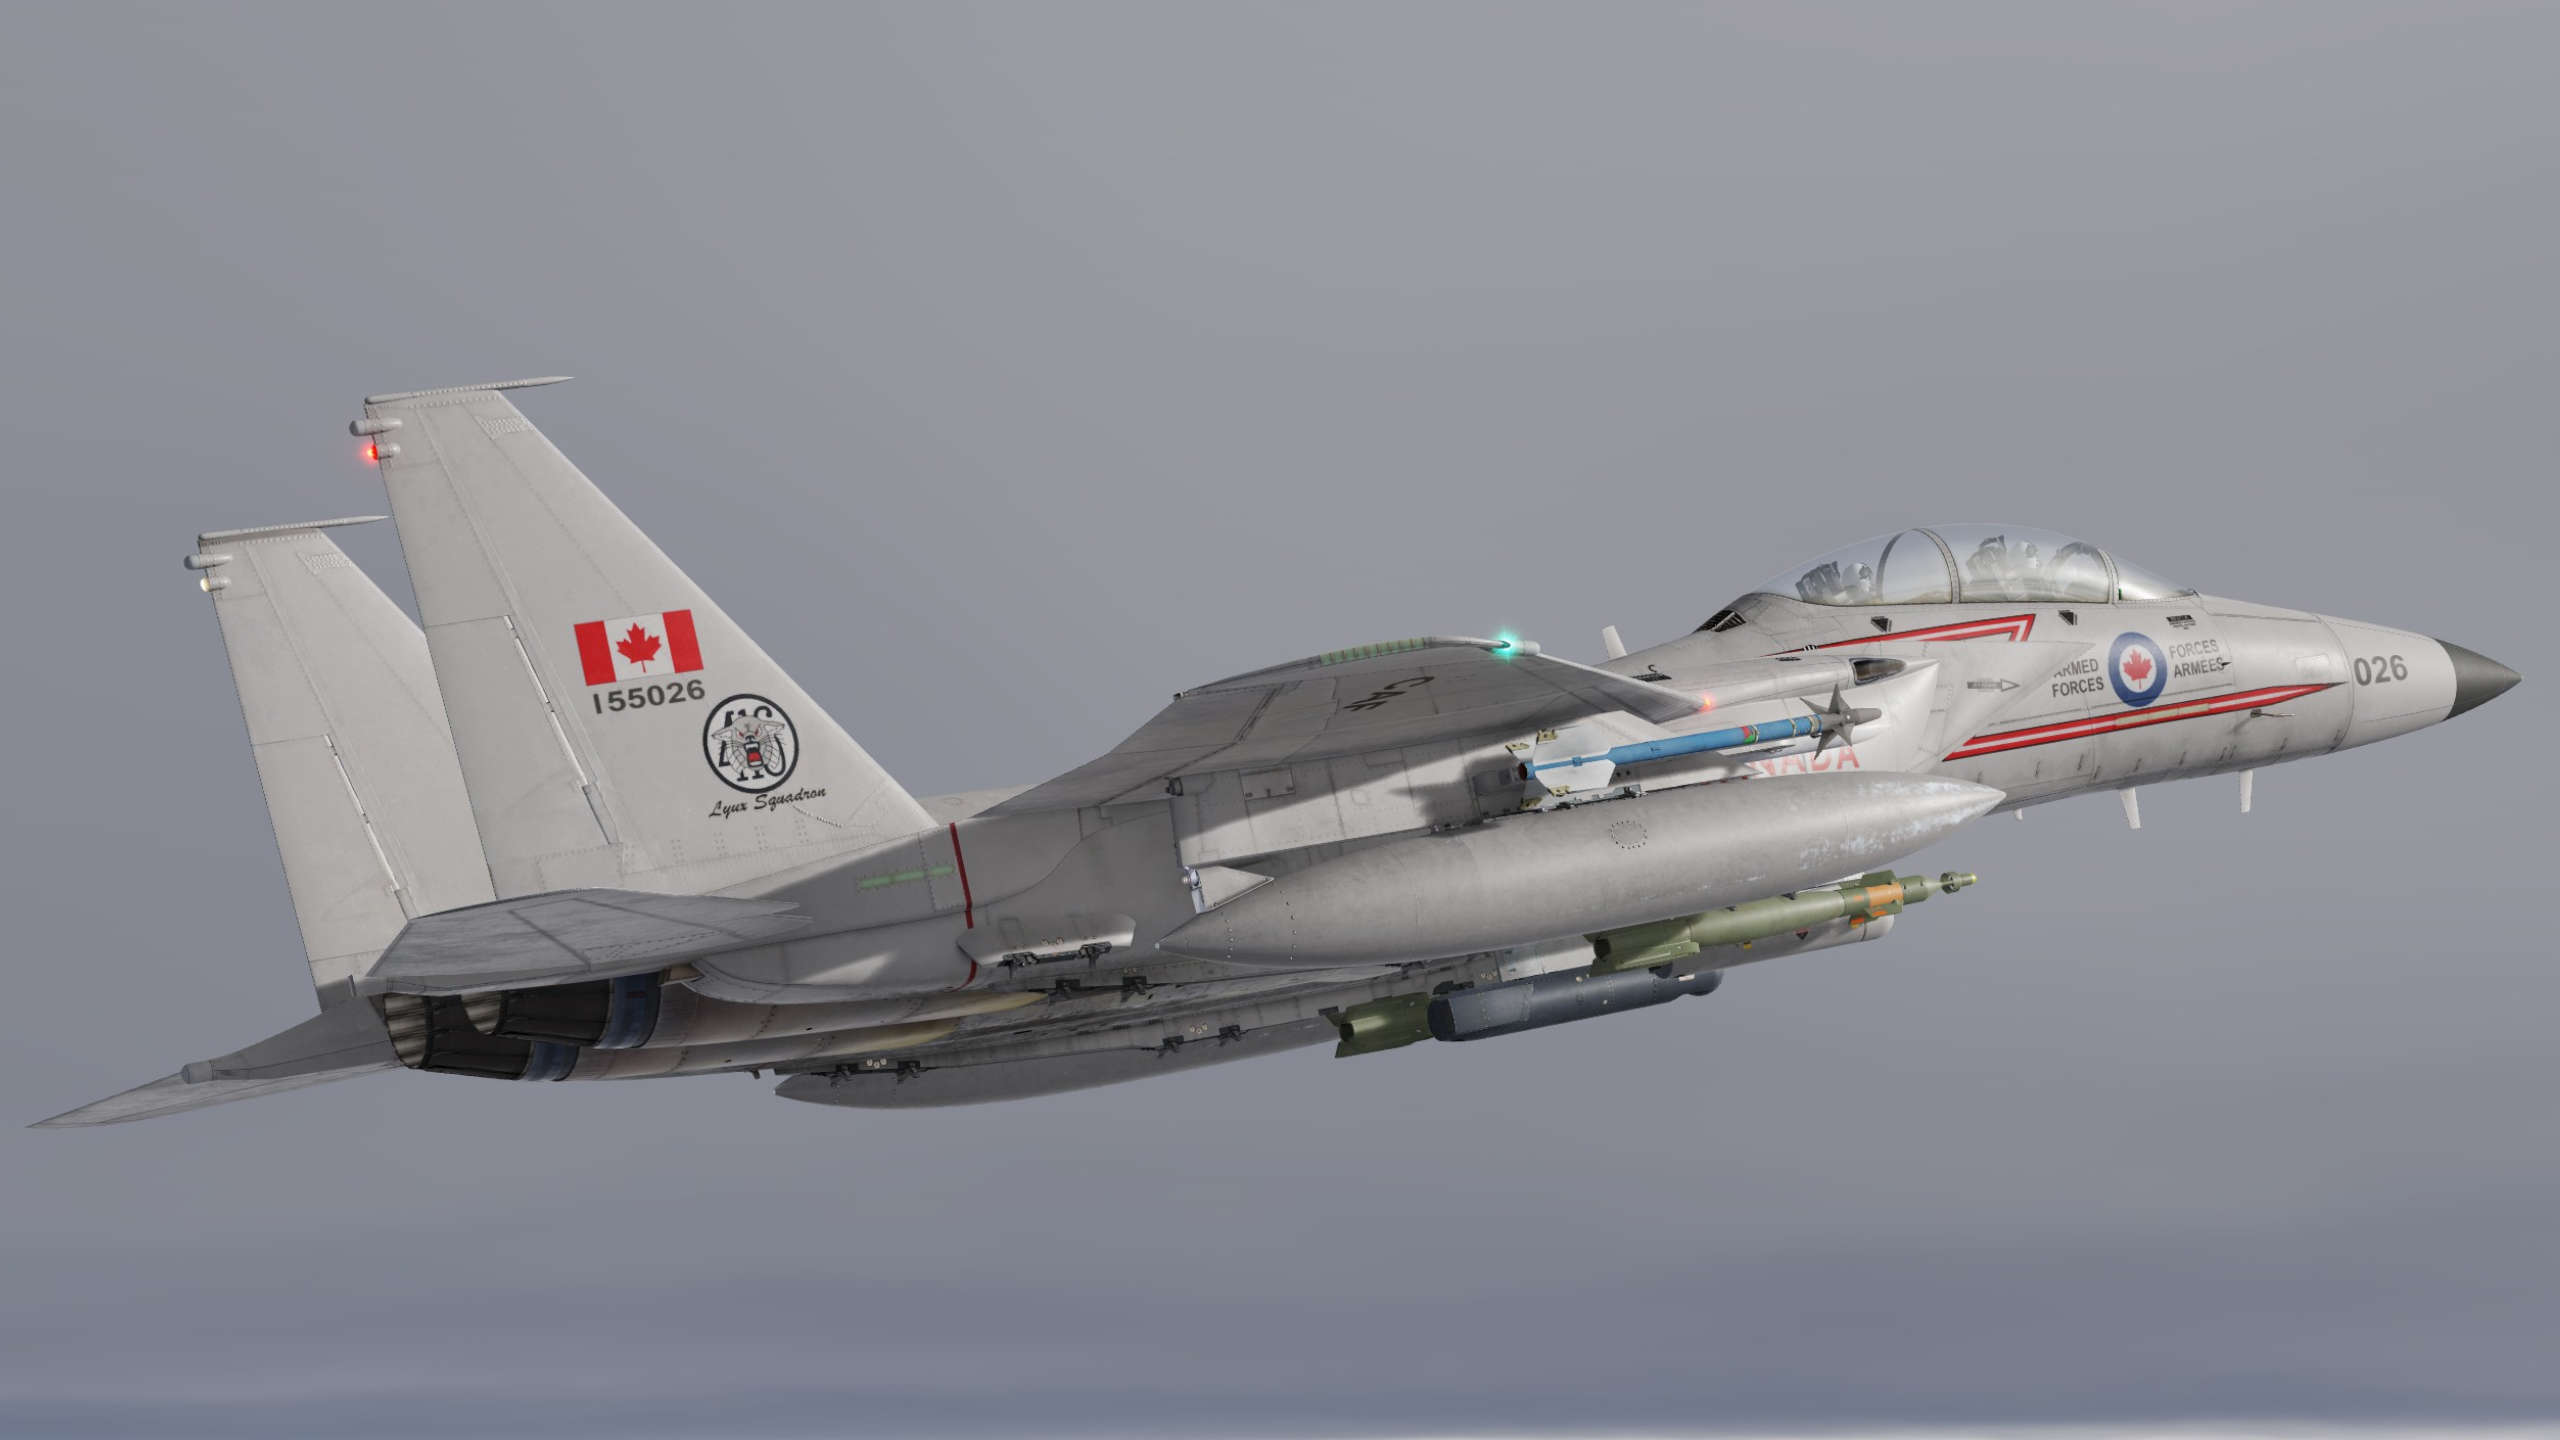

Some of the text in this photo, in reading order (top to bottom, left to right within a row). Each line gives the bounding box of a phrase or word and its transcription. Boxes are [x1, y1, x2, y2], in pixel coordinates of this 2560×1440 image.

[2169, 639, 2220, 658] FORCES
[2354, 655, 2408, 686] 026
[594, 679, 705, 714] 155026
[2051, 676, 2105, 698] FORCES
[753, 787, 827, 812] Squadron
